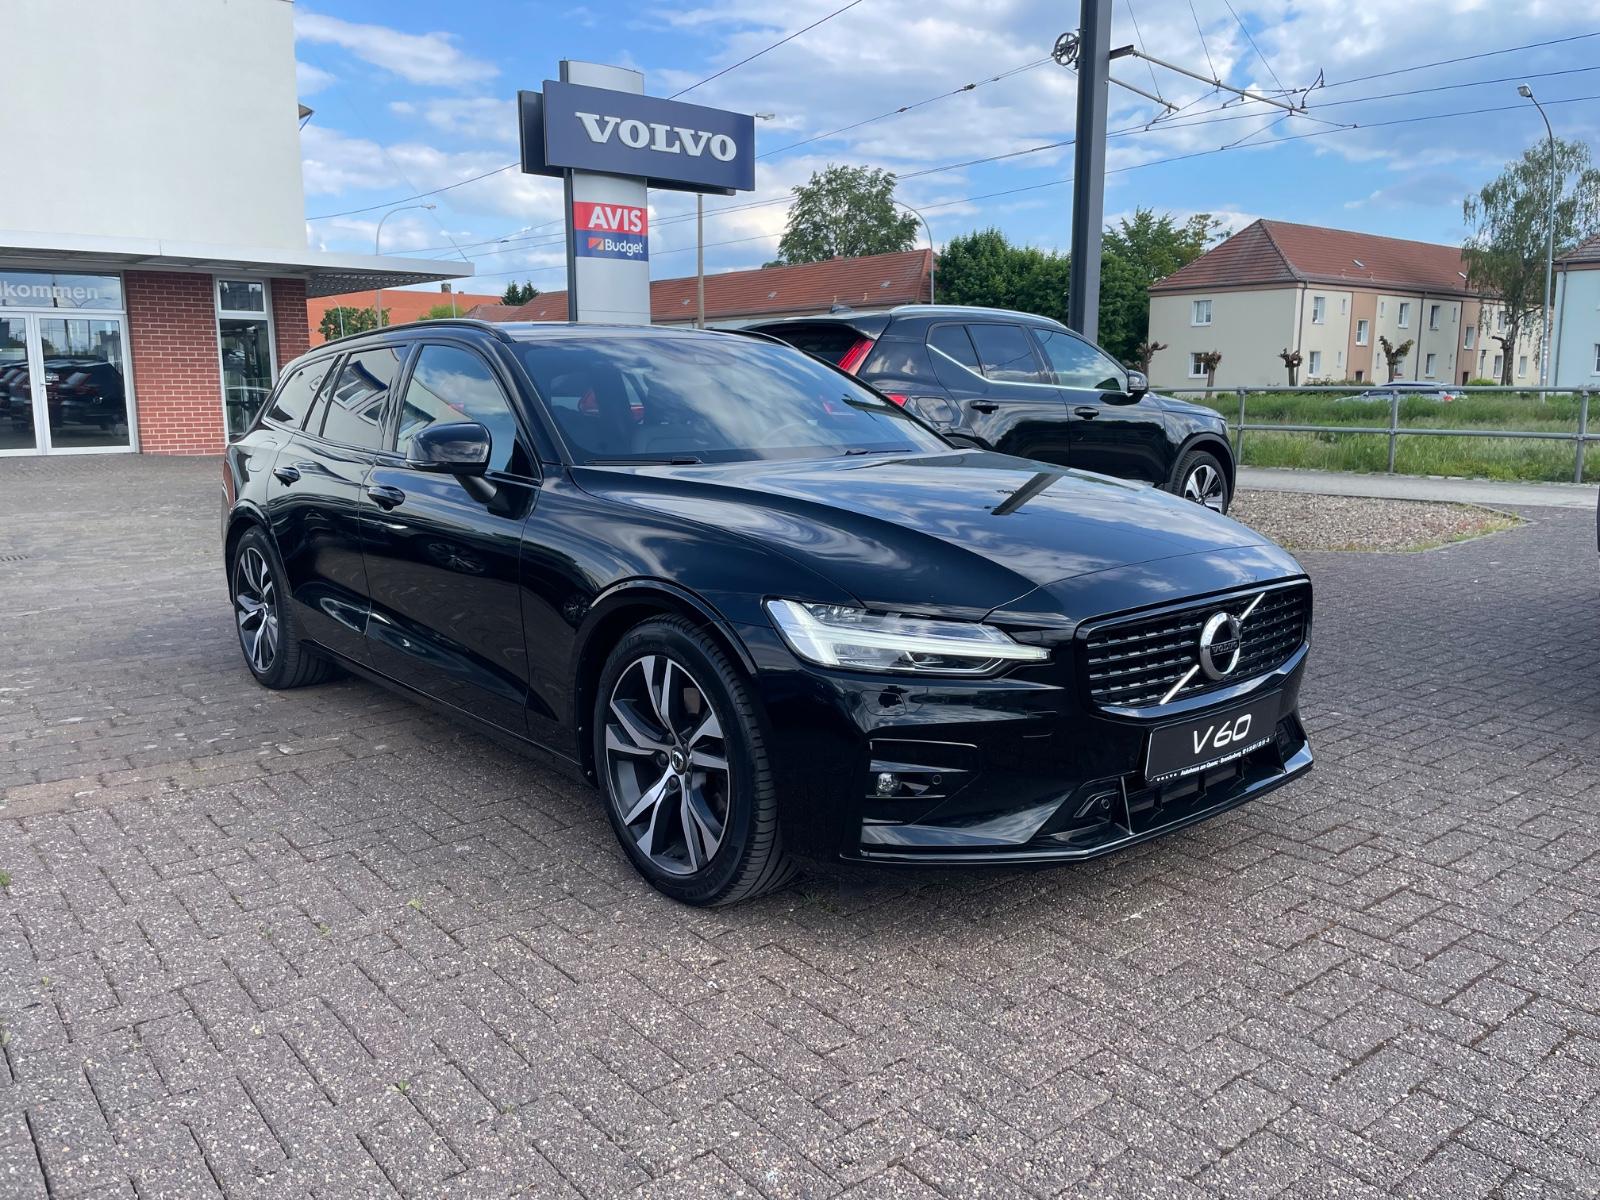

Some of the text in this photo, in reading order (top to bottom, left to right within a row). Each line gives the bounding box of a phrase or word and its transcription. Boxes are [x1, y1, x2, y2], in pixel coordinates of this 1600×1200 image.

[574, 111, 738, 163] VOLVO
[588, 206, 642, 232] AVIS
[605, 239, 643, 256] Budget
[1211, 641, 1239, 654] VOLVO
[1193, 713, 1252, 754] V60
